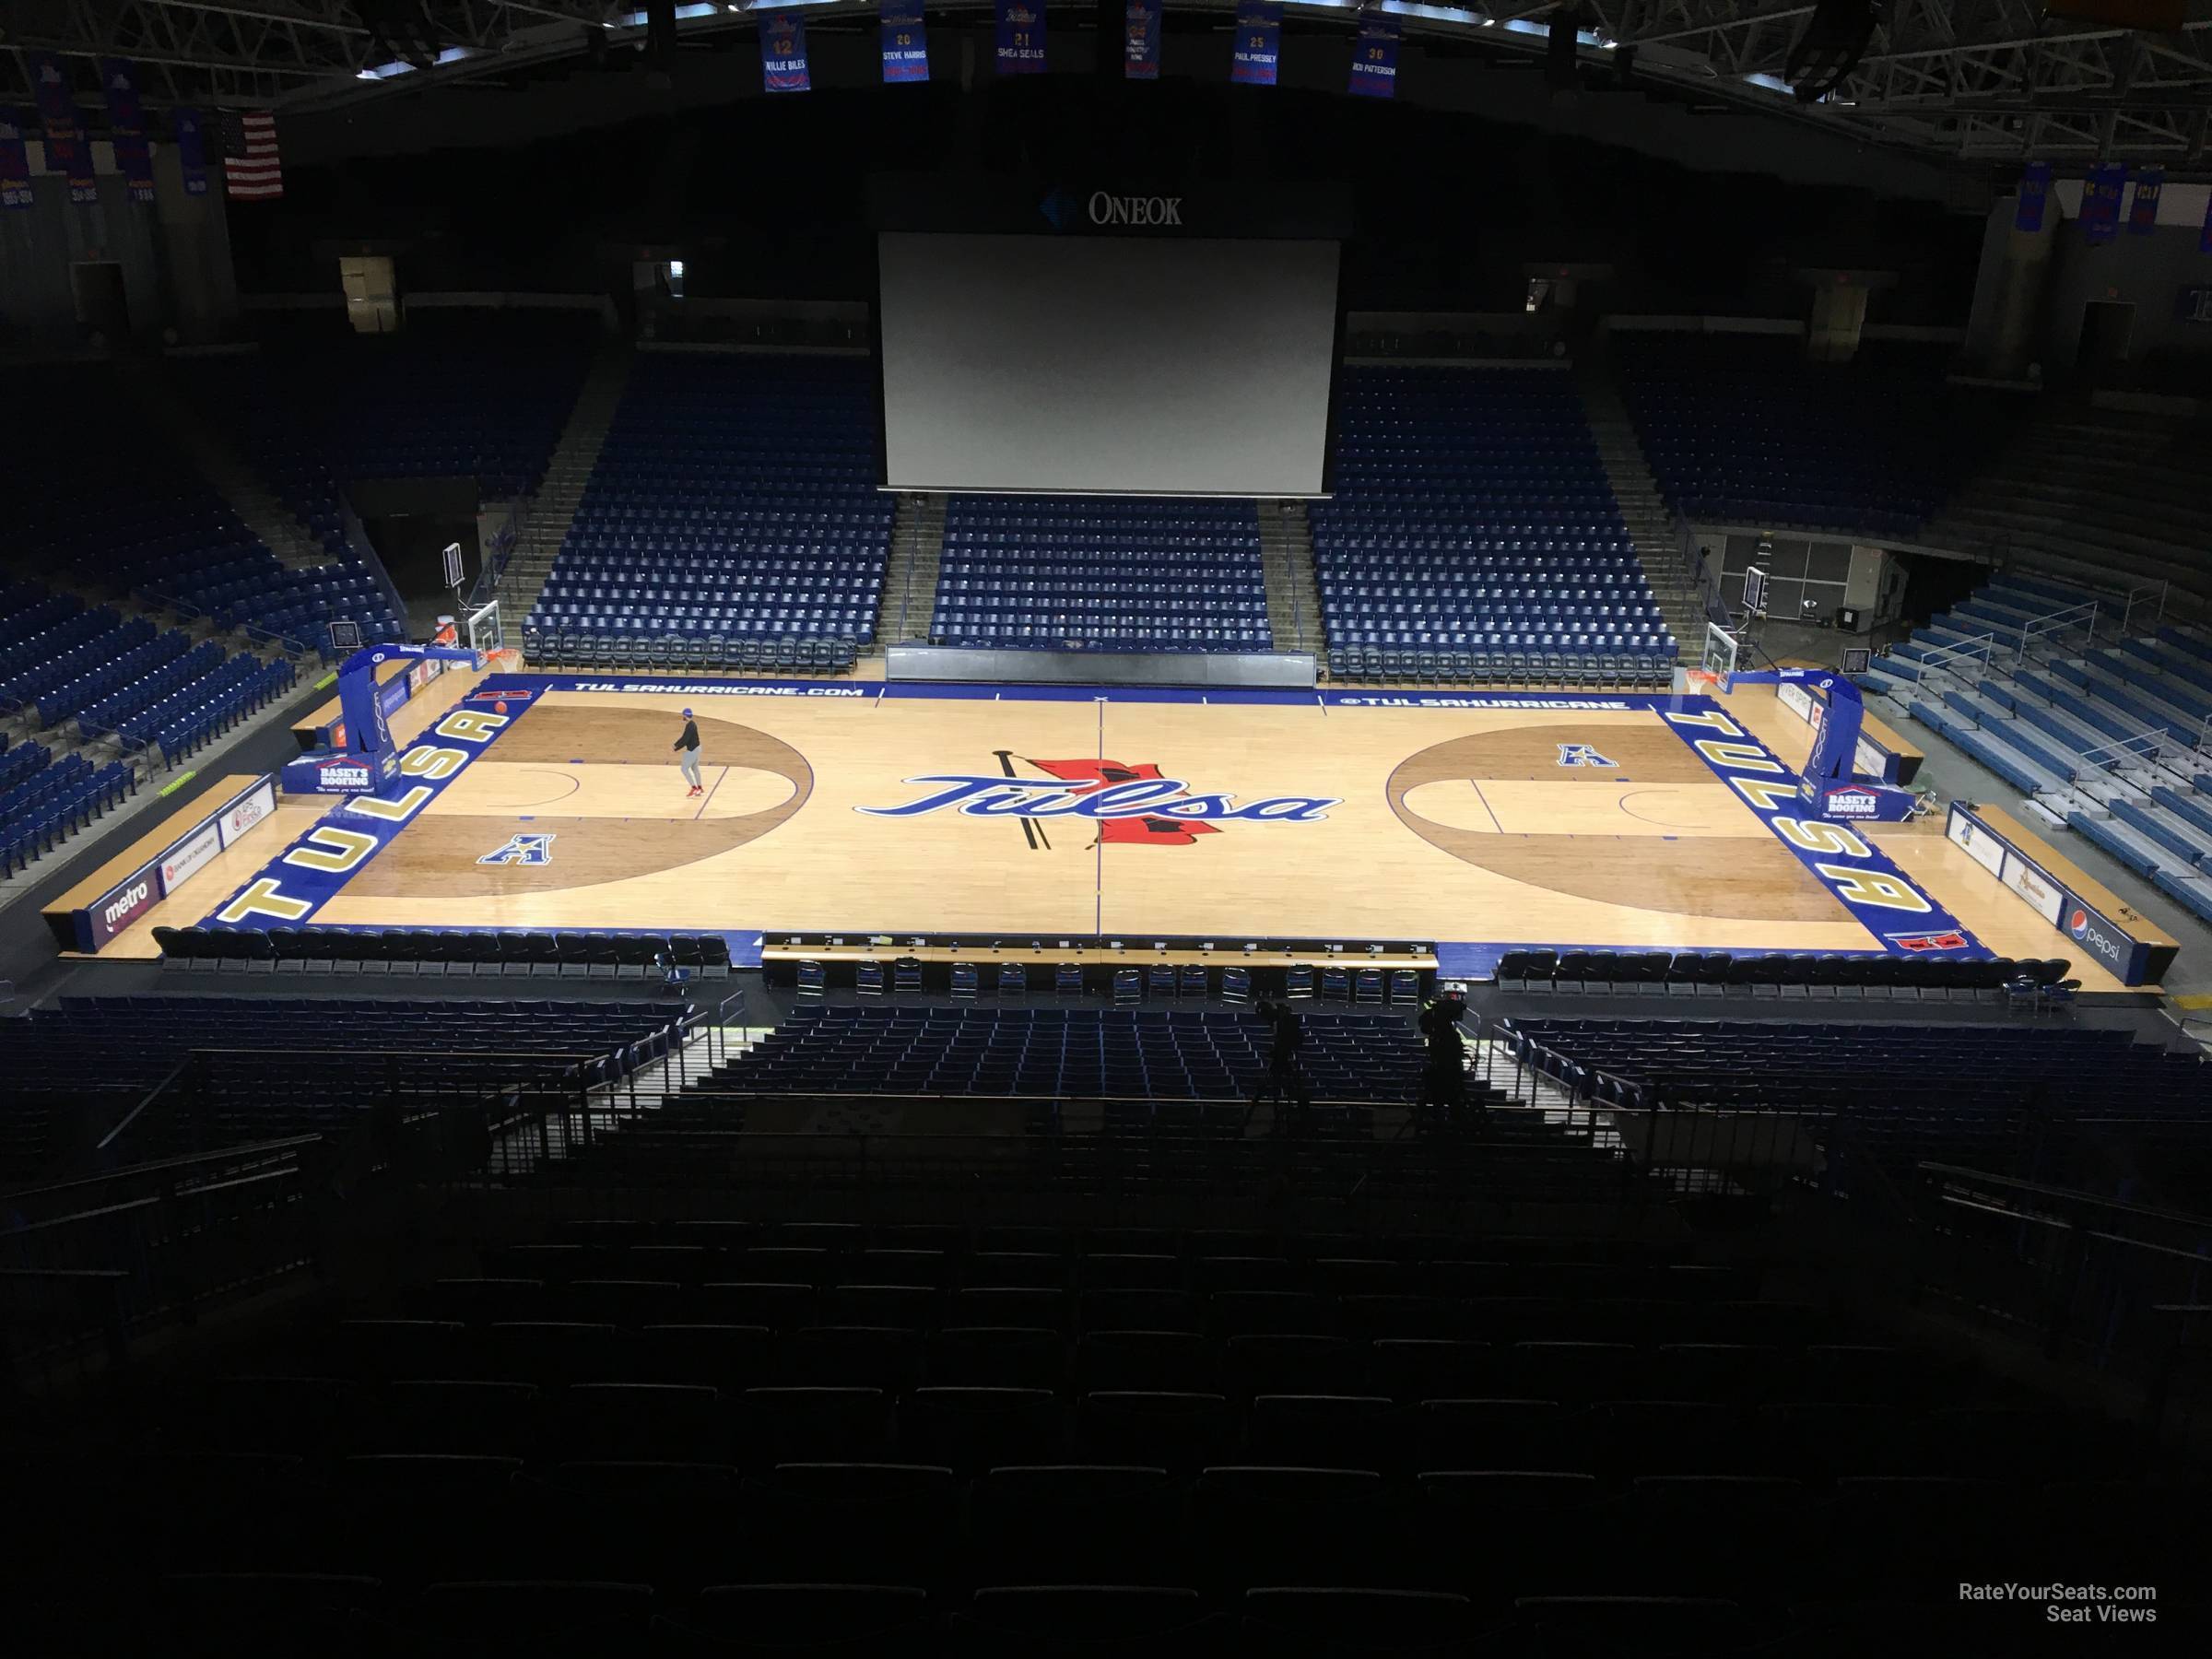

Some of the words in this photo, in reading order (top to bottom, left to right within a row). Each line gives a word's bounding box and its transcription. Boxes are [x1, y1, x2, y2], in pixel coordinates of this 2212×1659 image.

[883, 51, 902, 60] STEVE
[997, 47, 1018, 58] SHEA
[1018, 49, 1045, 59] SEALS
[1088, 191, 1183, 225] ONEOK
[574, 682, 865, 697] TULSAHURRICANE.COM
[1339, 696, 1631, 711] @TULSAHURRICANE
[320, 768, 369, 777] BASEY'S
[320, 777, 369, 785] ROOFING
[852, 774, 1346, 823] Tulsa
[1829, 794, 1877, 805] BASEY'S
[1664, 710, 1934, 913] TULSA
[1828, 804, 1876, 813] ROOFING
[216, 710, 511, 924] TULSA
[105, 882, 147, 924] metro
[2086, 925, 2121, 961] pepsi
